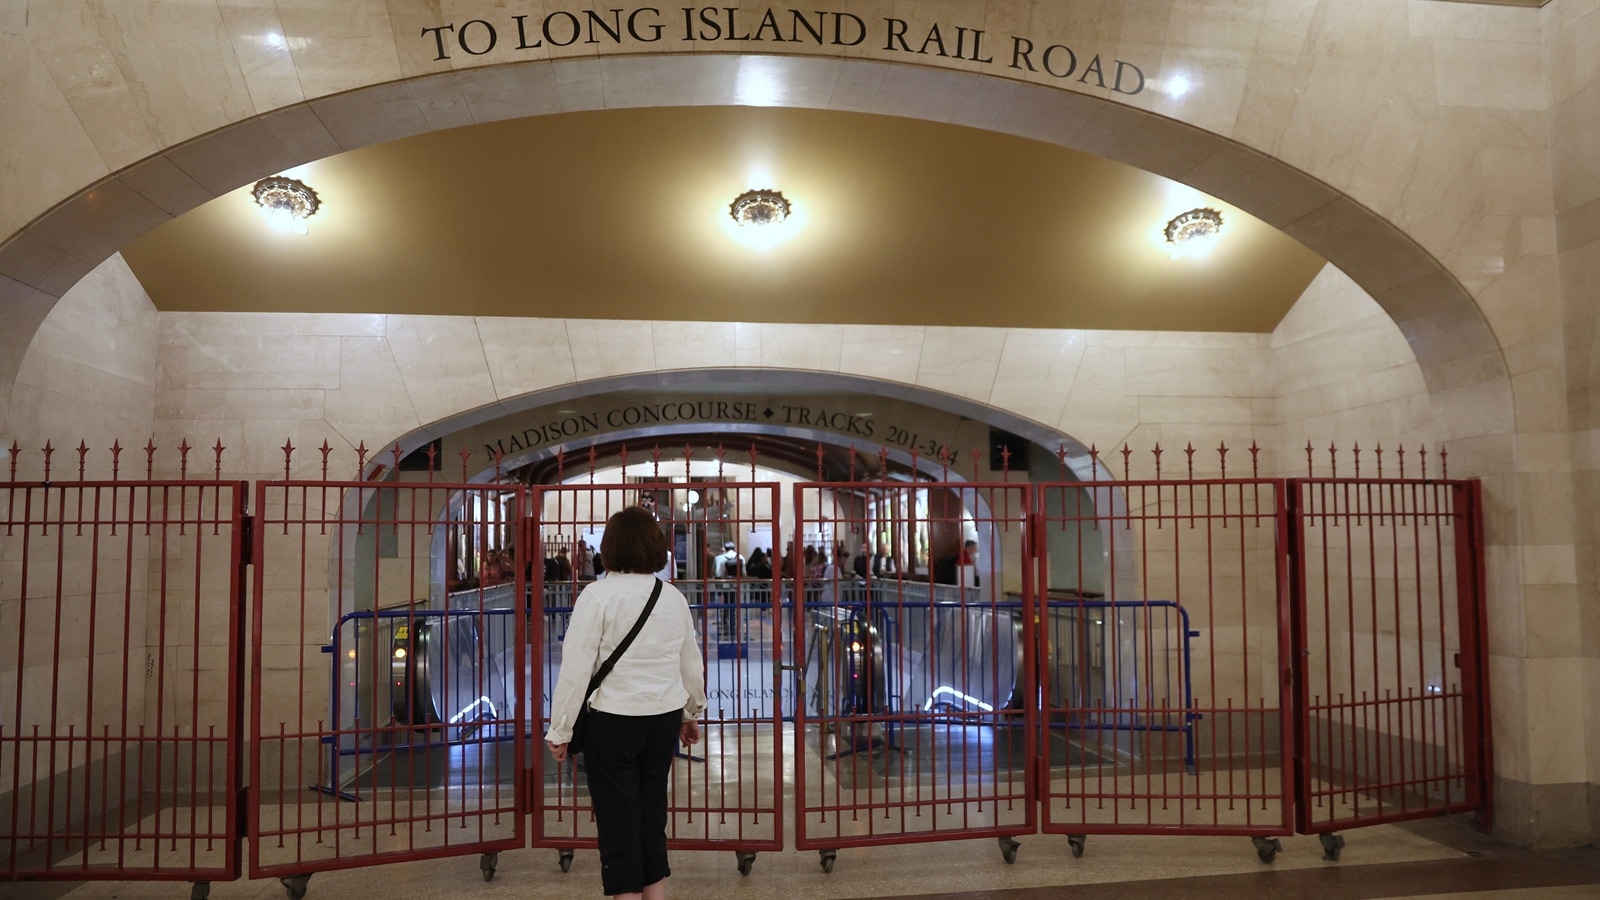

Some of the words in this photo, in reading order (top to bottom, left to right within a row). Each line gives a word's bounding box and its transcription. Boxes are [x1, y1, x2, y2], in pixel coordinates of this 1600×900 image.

[421, 20, 497, 61] TO
[511, 7, 666, 50] LONG
[681, 7, 867, 46] ISLAND
[883, 17, 994, 64] RAIL
[1008, 36, 1146, 96] ROAD
[483, 412, 599, 461] MADISON
[606, 402, 758, 428] CONCOURSE
[782, 405, 875, 437] TRACKS
[706, 689, 740, 700] ONG
